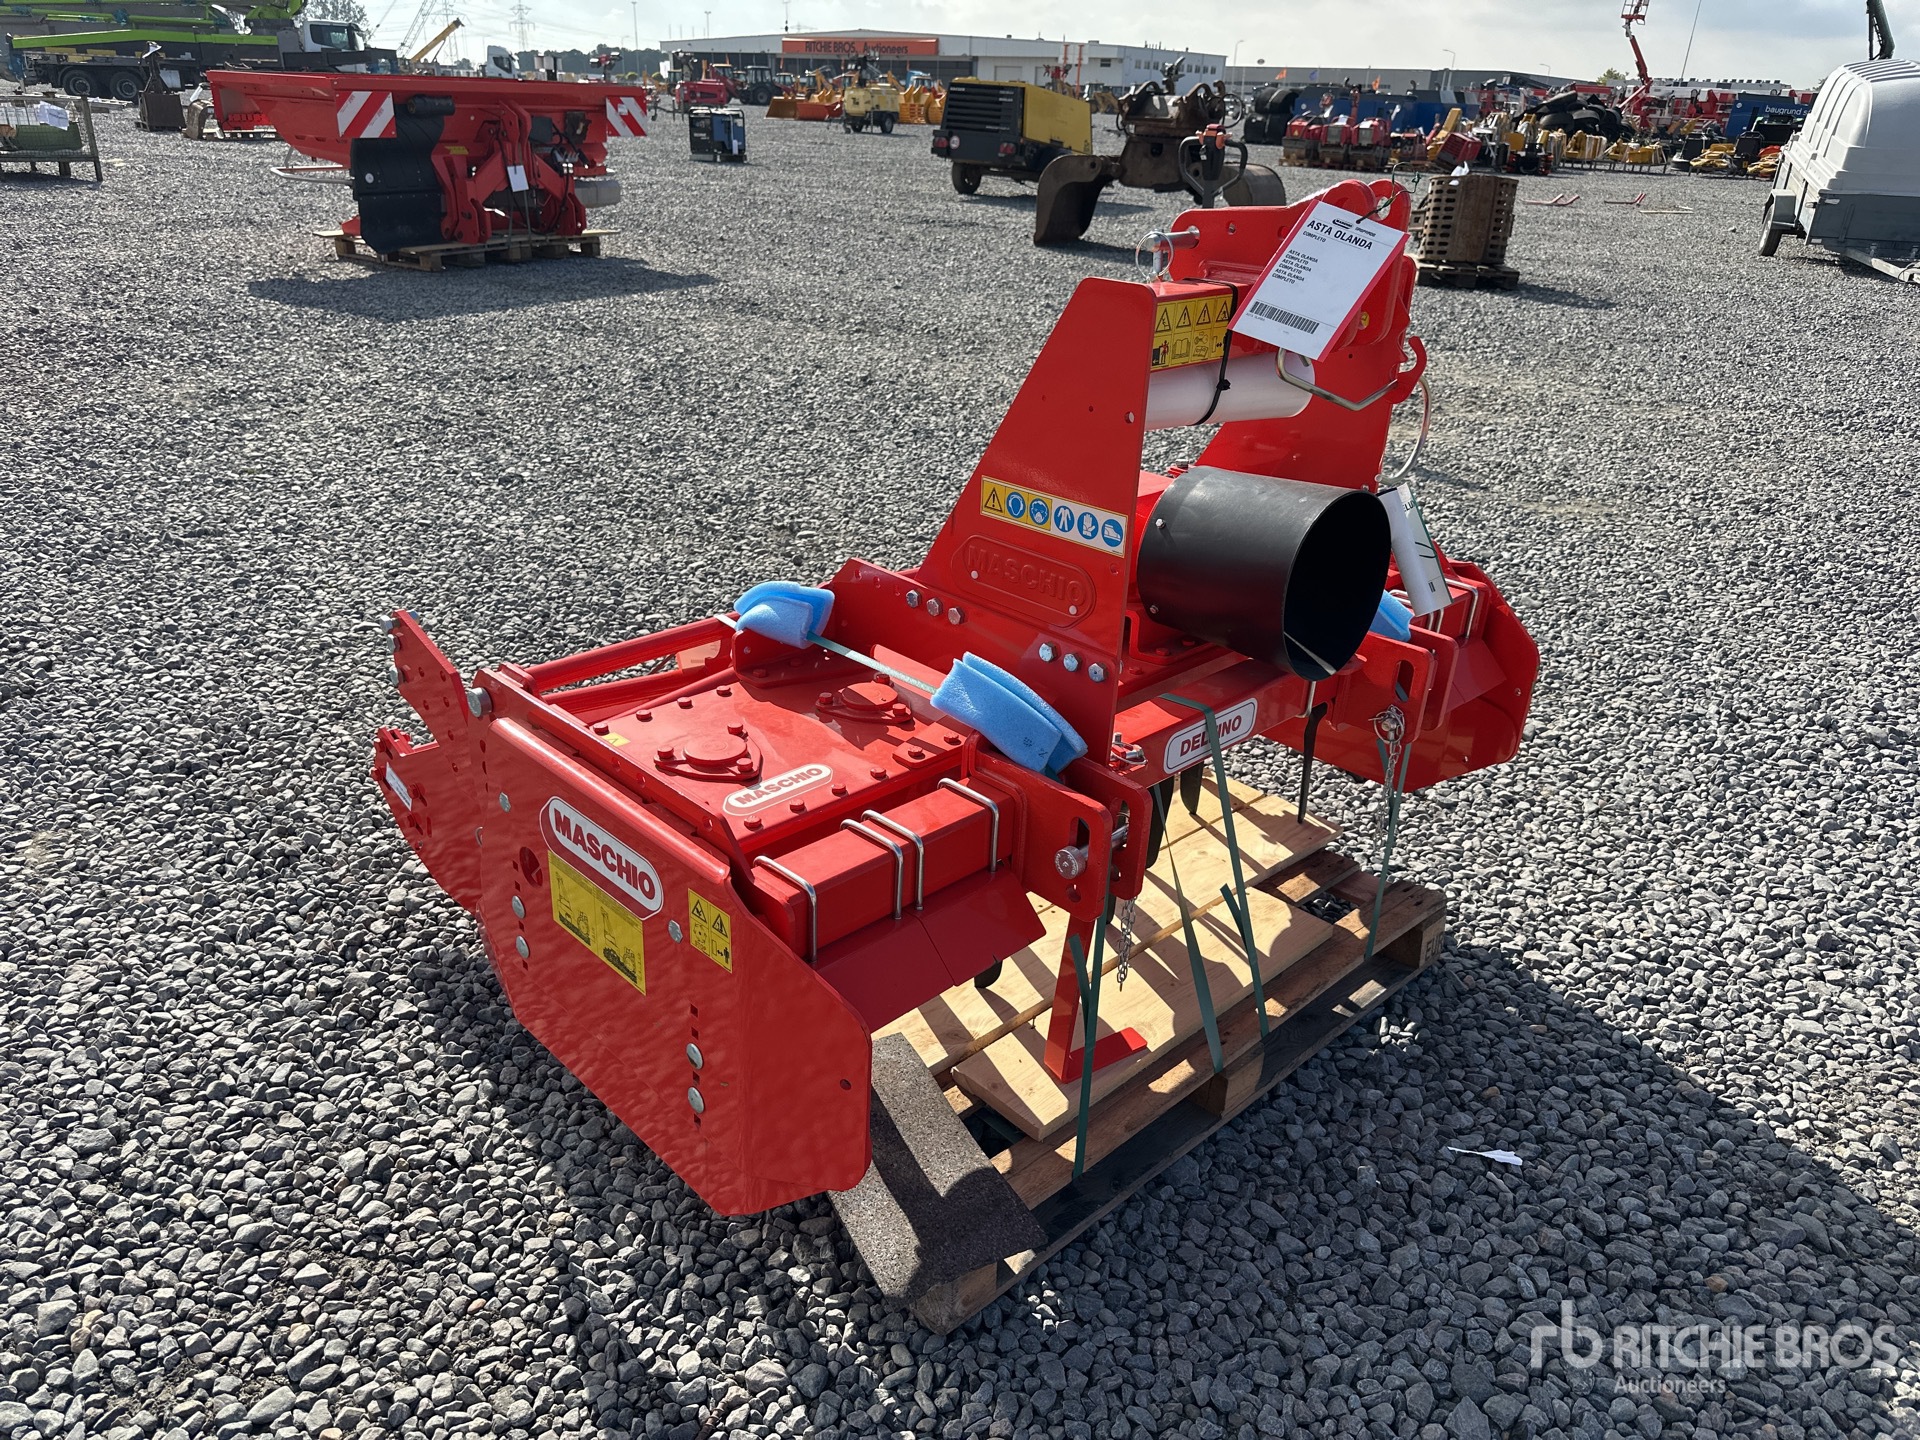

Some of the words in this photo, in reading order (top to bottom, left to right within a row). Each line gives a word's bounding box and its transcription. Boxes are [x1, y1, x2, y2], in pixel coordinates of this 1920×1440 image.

[805, 41, 831, 53] RITCHIE
[863, 41, 908, 54] Auctioneers
[1765, 105, 1803, 115] baugrund
[1302, 231, 1327, 243] COMPLETO
[1307, 220, 1333, 236] ASTA
[1334, 230, 1373, 250] OLANDA
[1285, 254, 1309, 265] COMPLETO
[1289, 249, 1300, 257] ASTA
[1300, 253, 1318, 263] OLANDA
[1279, 263, 1302, 275] COMPLETO
[1282, 258, 1293, 266] ASTA
[1294, 262, 1312, 272] OLANDA
[1272, 272, 1295, 284] COMPLETO
[1287, 272, 1305, 282] OLANDA
[967, 545, 1086, 606] MASCHIO
[1180, 715, 1242, 757] DELINO
[735, 768, 822, 805] MASCHIO
[554, 806, 655, 901] MASCHIO
